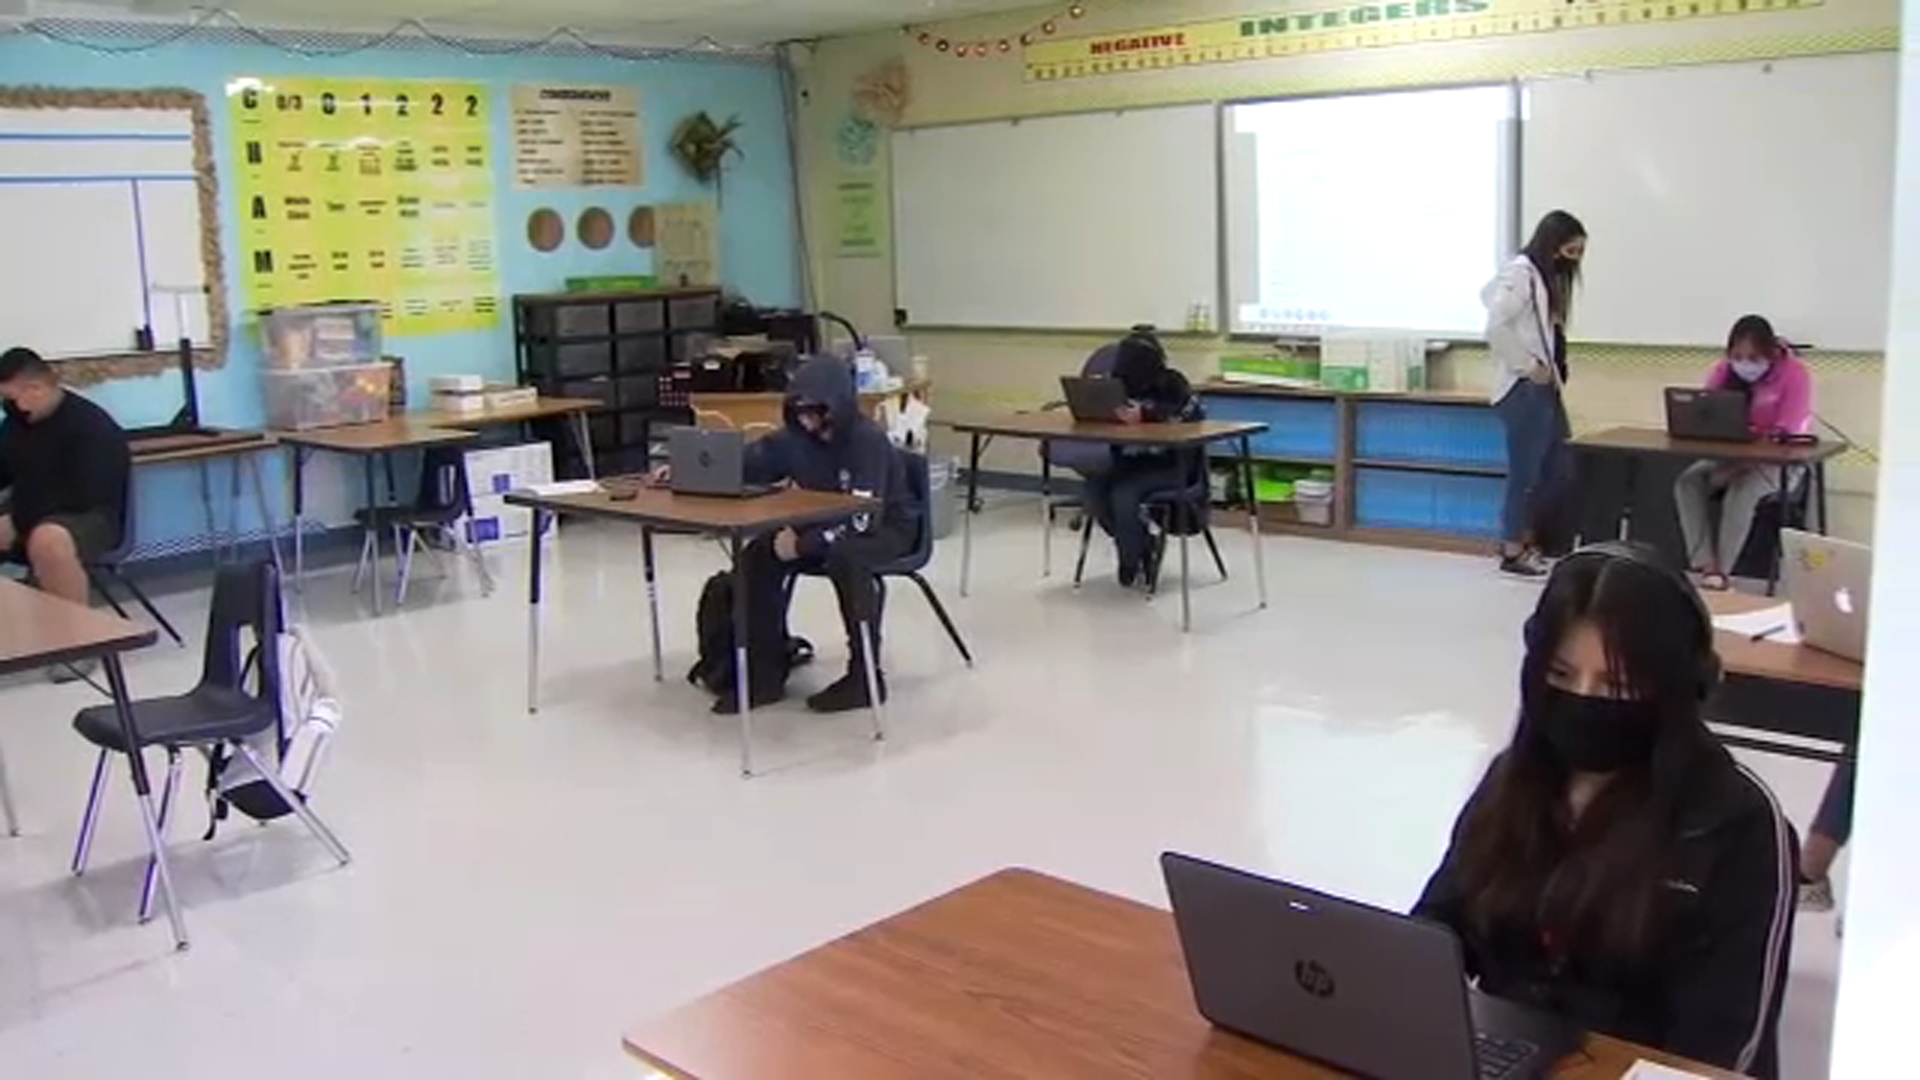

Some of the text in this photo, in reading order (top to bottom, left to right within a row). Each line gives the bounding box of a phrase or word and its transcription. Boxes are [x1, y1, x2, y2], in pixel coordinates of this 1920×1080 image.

[1240, 0, 1488, 36] INTEGERS
[1090, 33, 1186, 54] NEGATIVE
[242, 87, 257, 109] C
[321, 92, 335, 115] 0
[360, 92, 371, 115] 1
[396, 93, 409, 116] 2
[431, 93, 443, 115] 2
[465, 95, 478, 117] 2
[252, 195, 267, 219] A
[255, 250, 273, 273] M
[1295, 960, 1335, 998] hp
